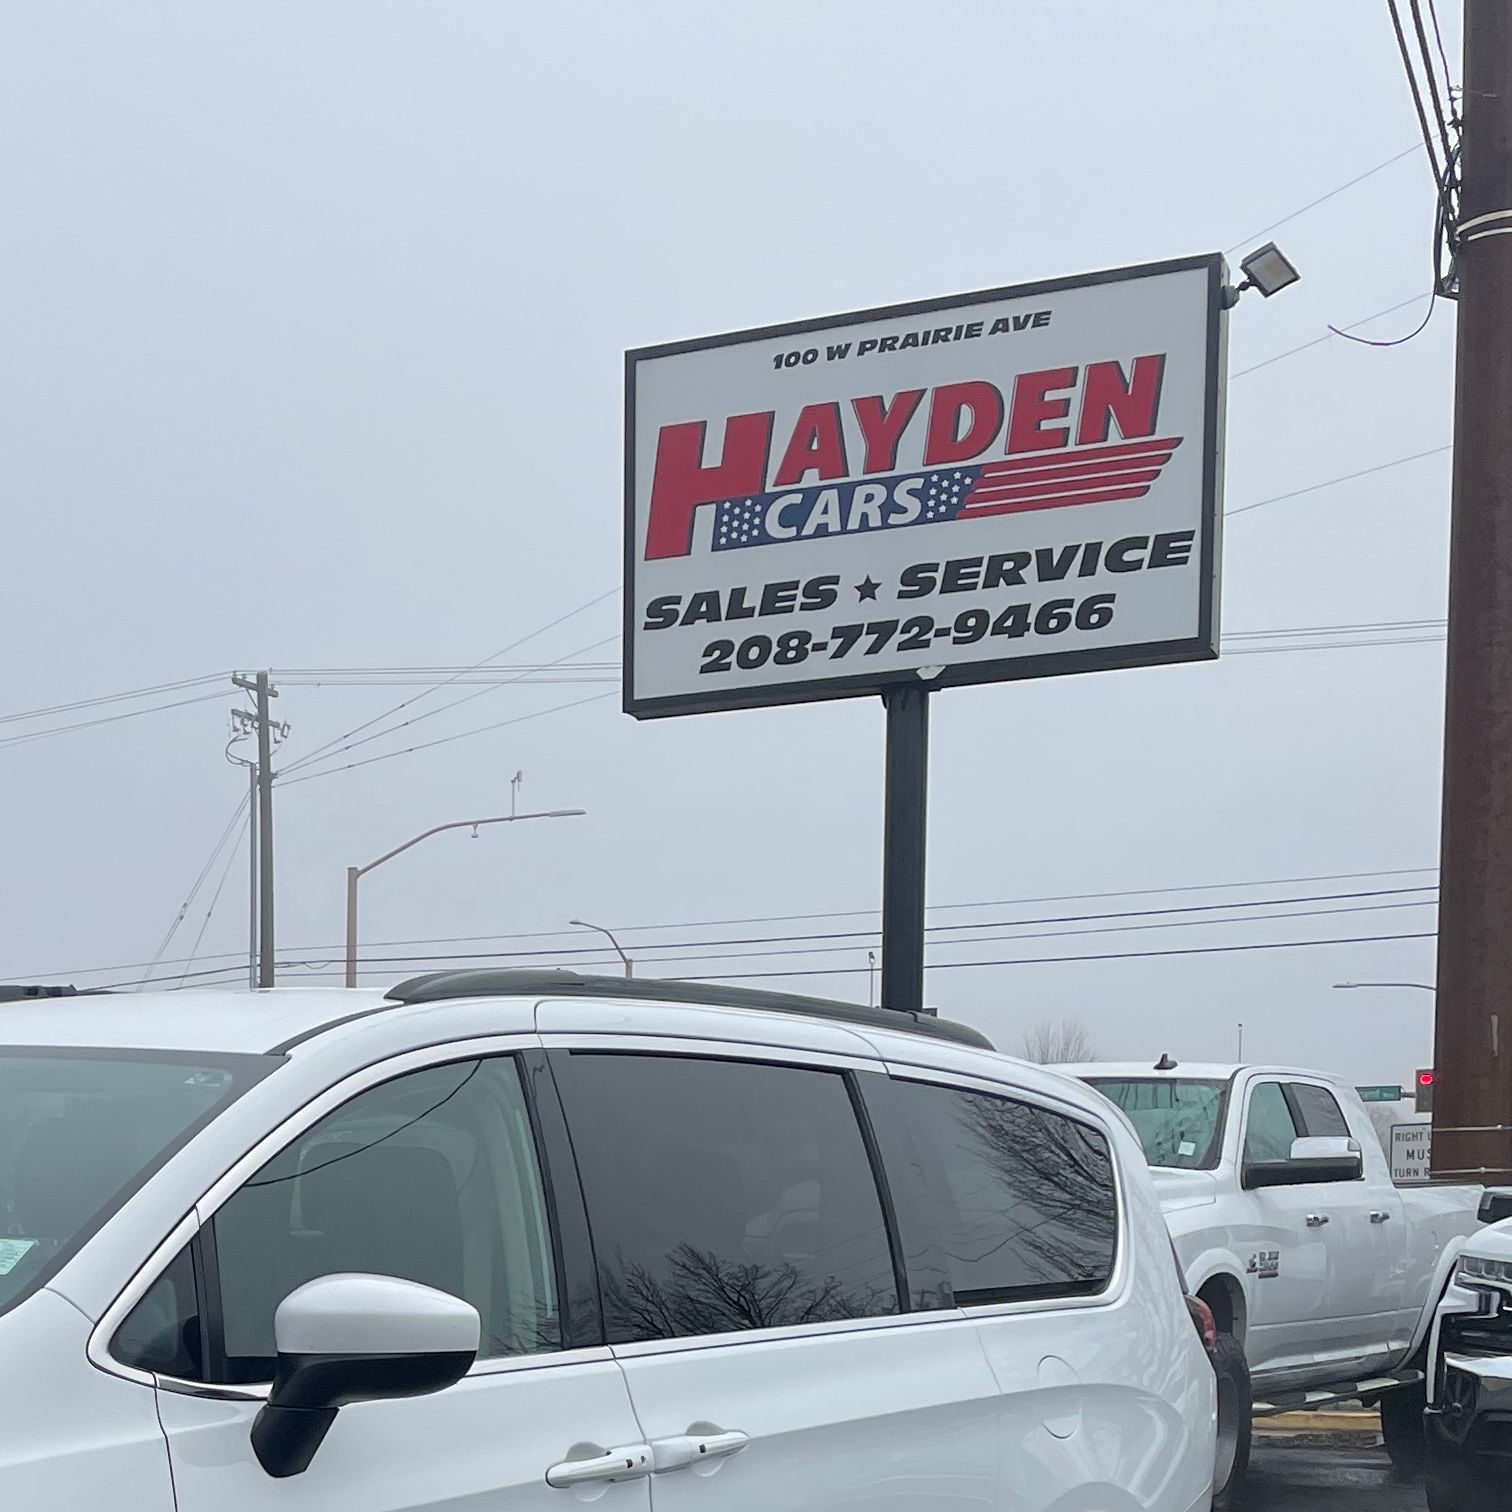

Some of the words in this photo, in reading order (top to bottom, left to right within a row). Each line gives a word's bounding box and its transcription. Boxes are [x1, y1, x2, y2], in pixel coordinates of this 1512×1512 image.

[773, 347, 818, 369] 100
[826, 342, 852, 361] W
[856, 321, 984, 357] PRAIRIE
[988, 309, 1053, 336] AVE
[644, 352, 1167, 560] HAYDEN
[764, 476, 927, 539] CARS
[642, 574, 842, 631] SALES
[896, 529, 1197, 599] SERVICE
[698, 592, 1118, 675] 208-772-9466
[1394, 1131, 1424, 1142] RIGHT
[1406, 1148, 1431, 1161] MUS
[1394, 1167, 1420, 1178] TURN
